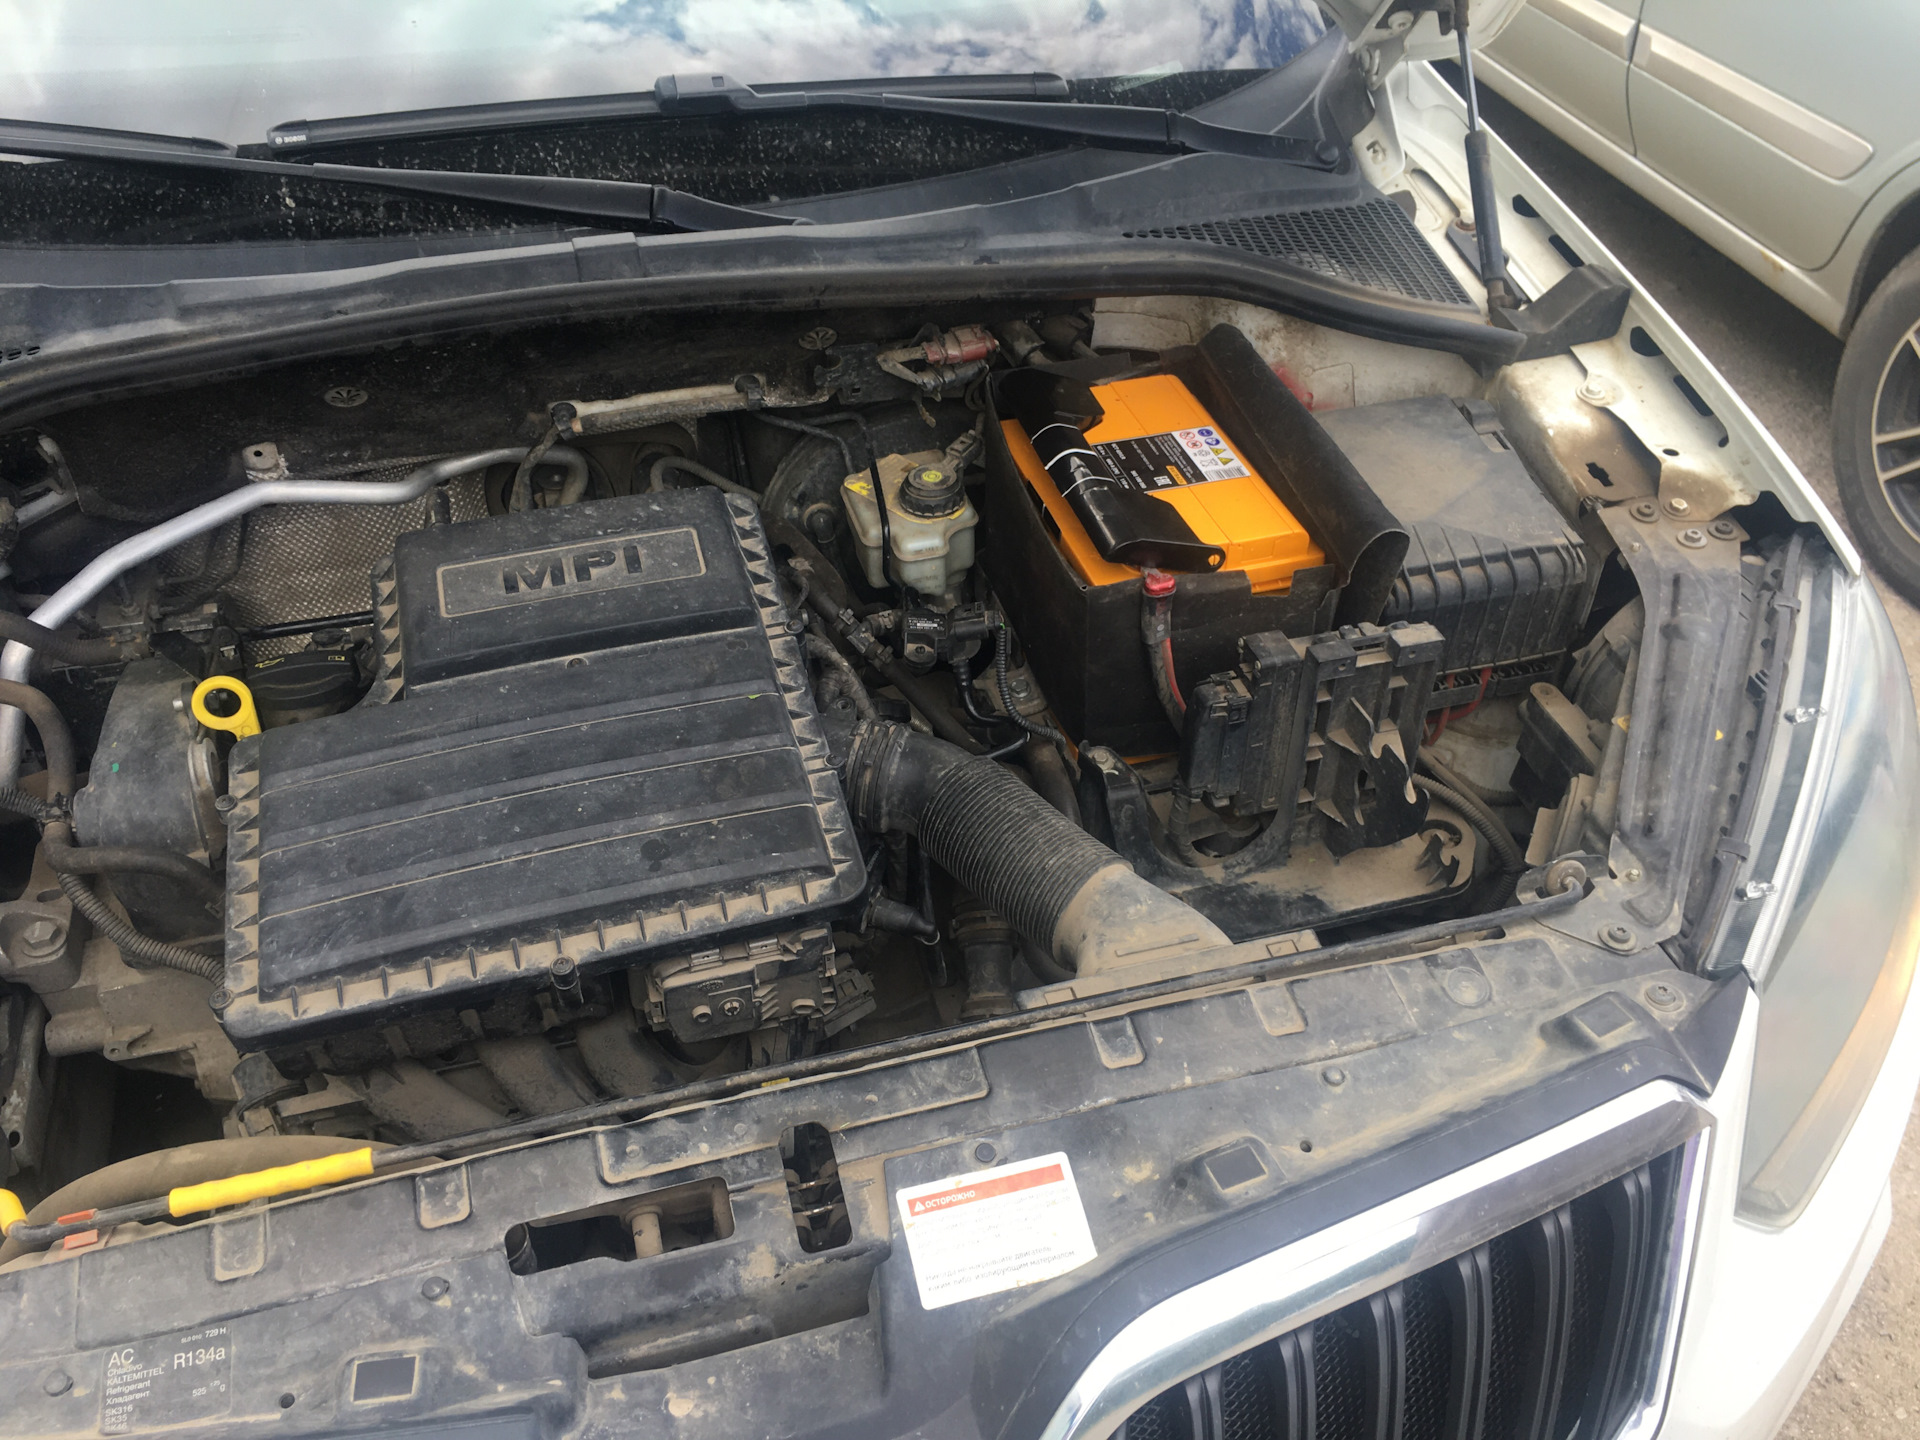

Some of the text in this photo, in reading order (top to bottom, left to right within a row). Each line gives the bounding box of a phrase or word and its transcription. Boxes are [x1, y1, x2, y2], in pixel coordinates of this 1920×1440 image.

[503, 545, 643, 594] MPI
[925, 1190, 976, 1209] ОСТОРОЖНО
[205, 1328, 219, 1338] 729
[220, 1327, 227, 1335] H
[108, 1348, 134, 1368] AC
[173, 1346, 226, 1370] R134a
[107, 1363, 143, 1377] Chladivo
[106, 1379, 151, 1396] Refrigerant
[192, 1386, 207, 1397] 525
[106, 1390, 150, 1406] Хладагент
[105, 1404, 133, 1417] SK316
[104, 1413, 128, 1425] SK35
